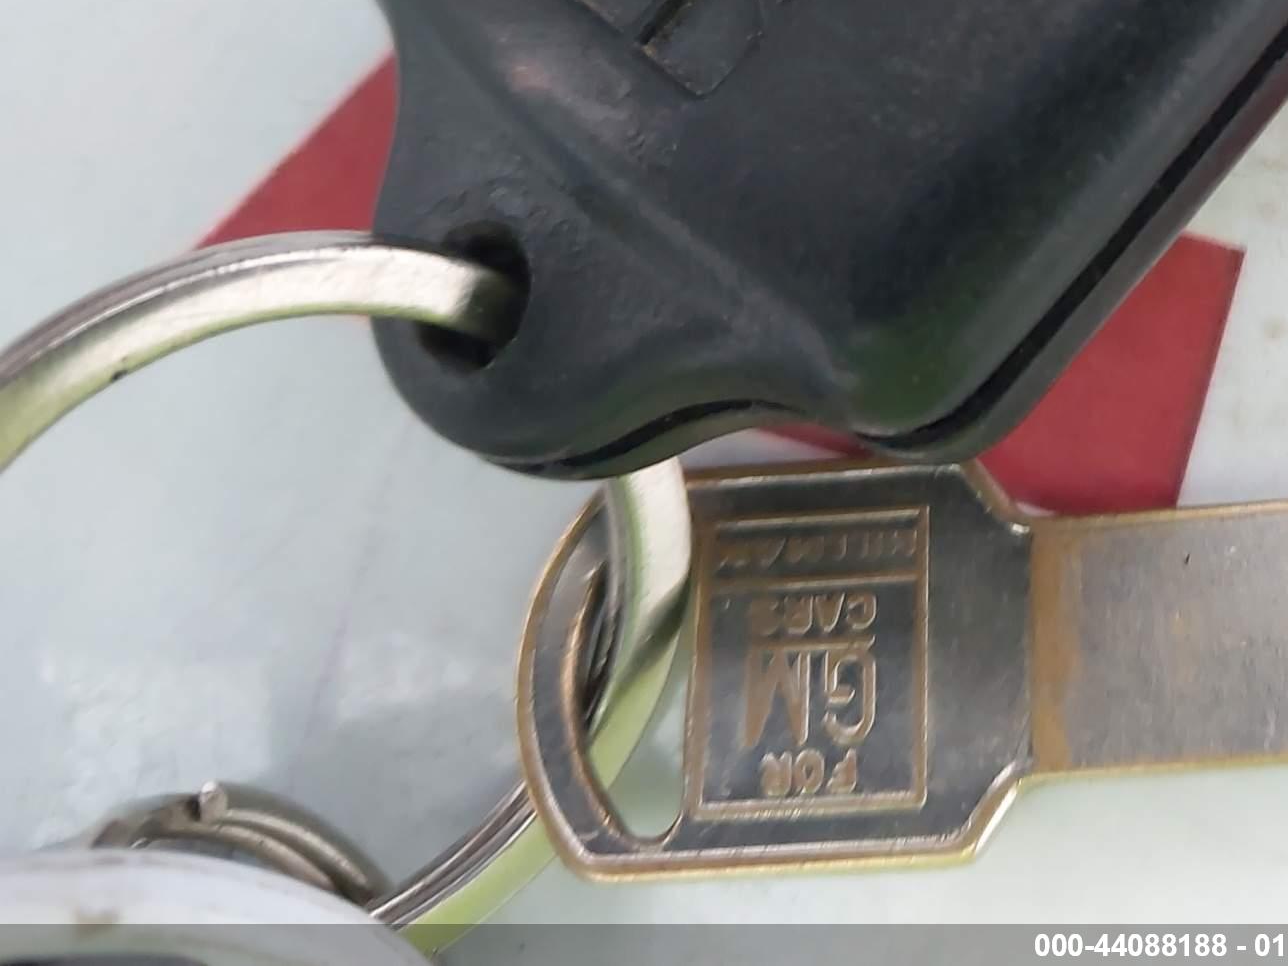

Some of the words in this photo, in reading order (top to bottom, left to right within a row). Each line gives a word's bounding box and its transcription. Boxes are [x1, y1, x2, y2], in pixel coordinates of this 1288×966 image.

[748, 590, 877, 635] CARS
[743, 648, 877, 748] GM
[760, 747, 858, 796] FOR
